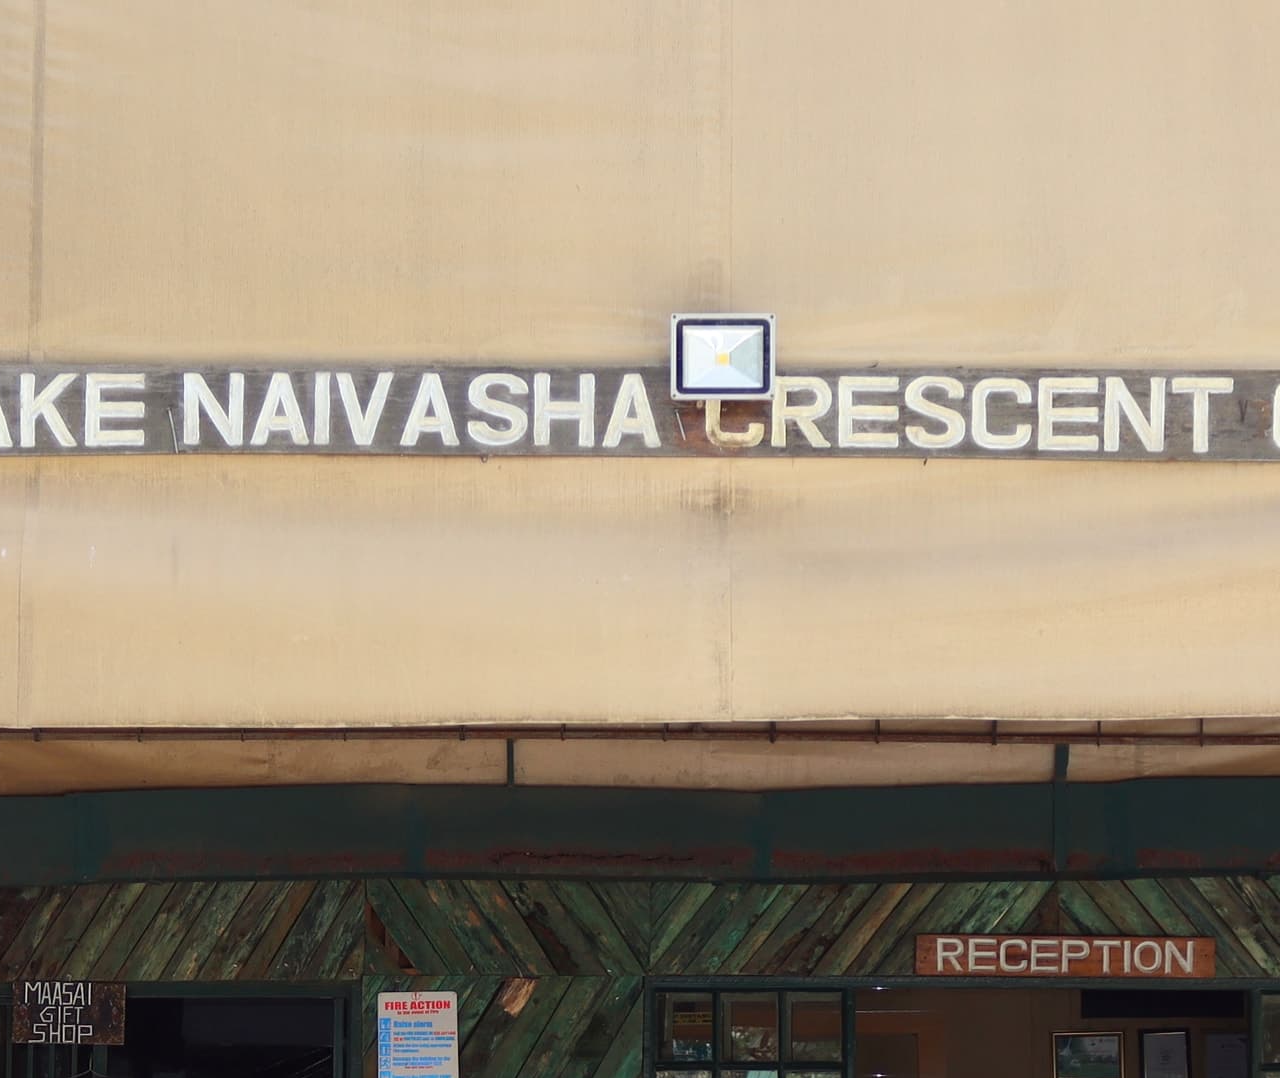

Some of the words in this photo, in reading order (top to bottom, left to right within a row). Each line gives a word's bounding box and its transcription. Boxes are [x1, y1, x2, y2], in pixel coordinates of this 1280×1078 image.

[182, 371, 663, 450] NAIVASHA
[704, 375, 1235, 454] CRESCENT
[935, 937, 1195, 975] RECEPTION
[24, 981, 92, 1006] MAASAI
[384, 1002, 408, 1010] FIRE
[410, 1000, 451, 1010] ACTION
[39, 1006, 84, 1025] GIFT
[27, 1023, 93, 1044] SHOP
